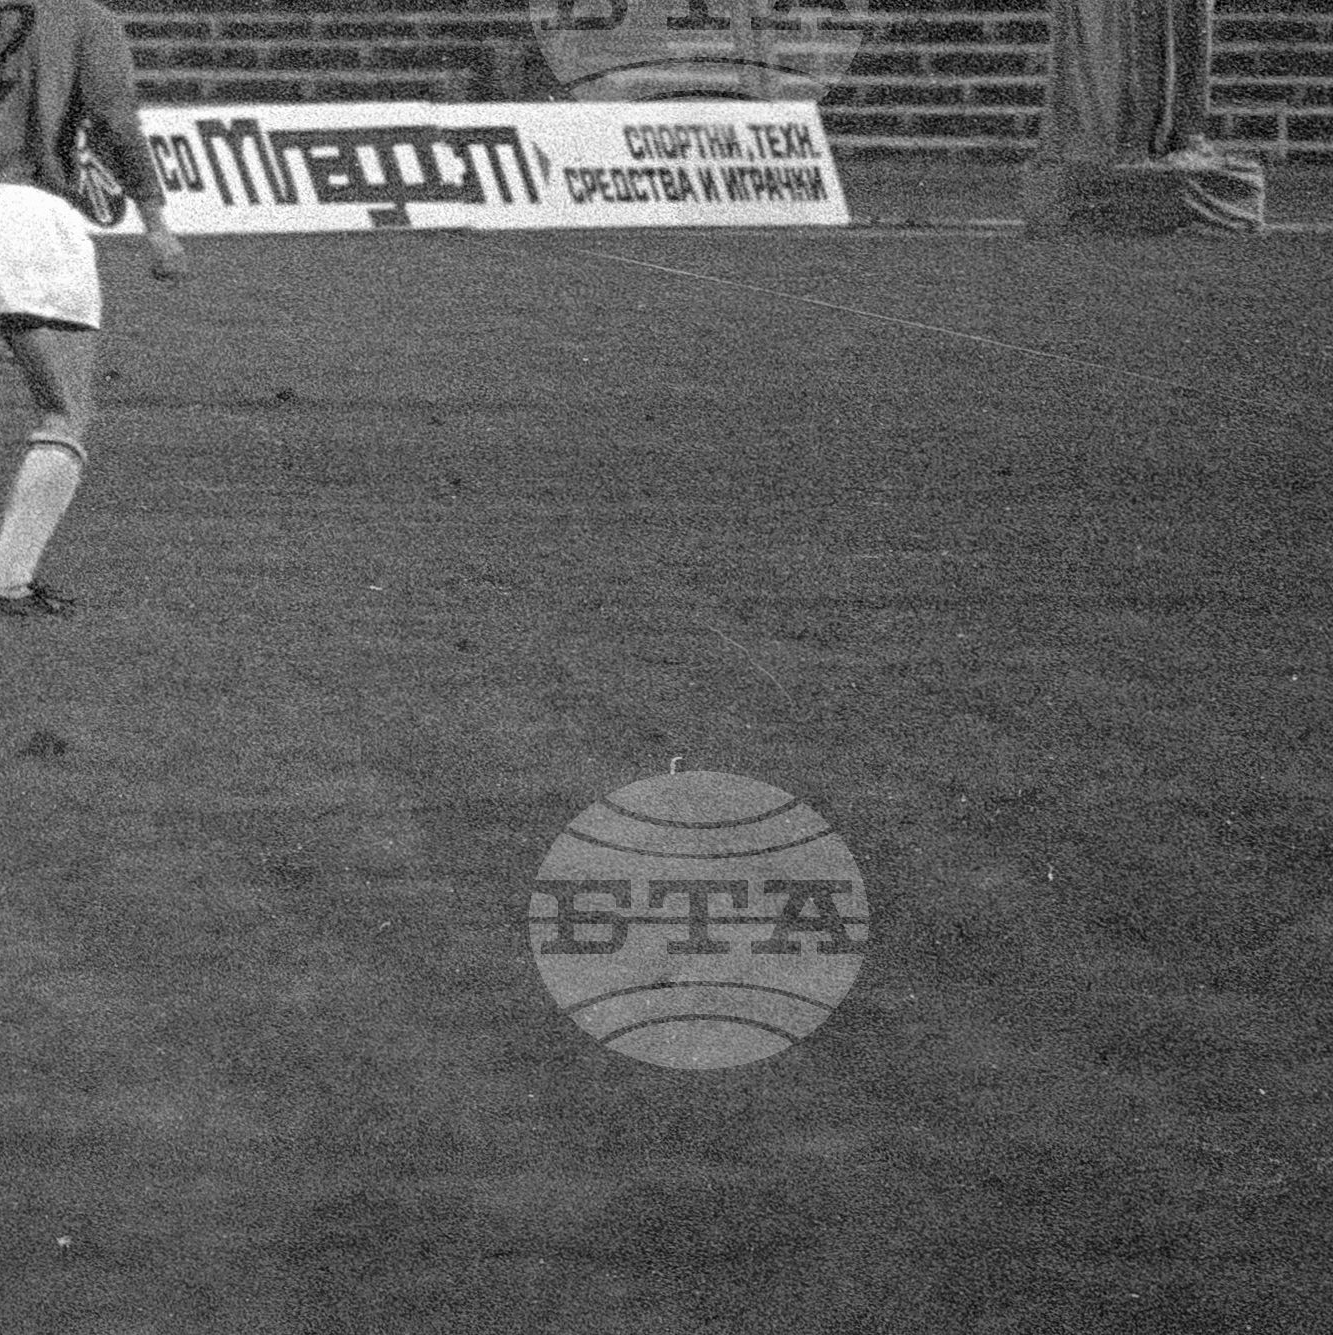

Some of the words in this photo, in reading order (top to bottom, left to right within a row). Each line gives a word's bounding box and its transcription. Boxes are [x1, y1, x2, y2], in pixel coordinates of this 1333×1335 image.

[563, 167, 699, 204] СРЕДСТВА
[697, 167, 721, 202] И
[719, 166, 829, 202] ИГРАЧКИ
